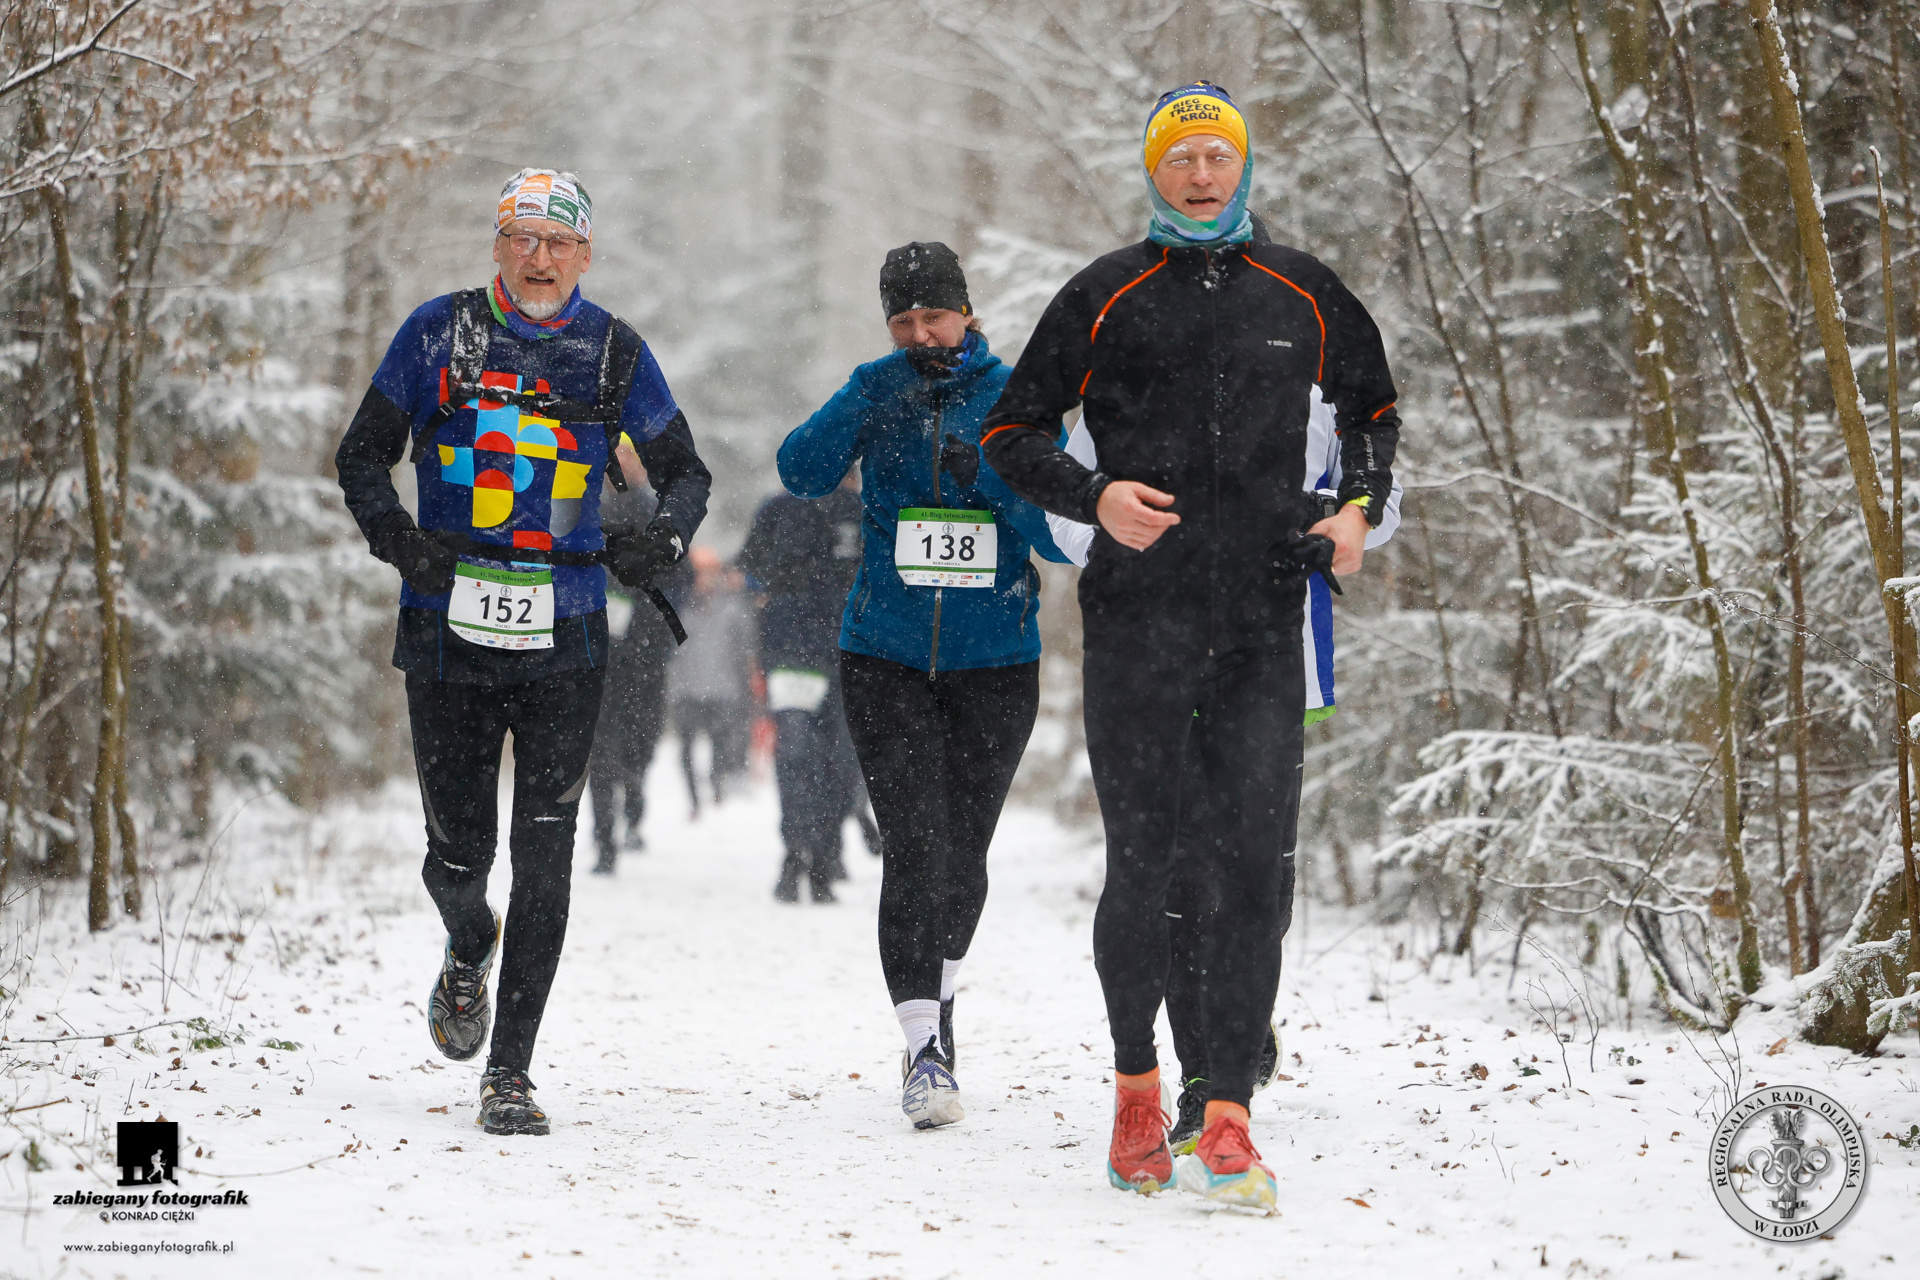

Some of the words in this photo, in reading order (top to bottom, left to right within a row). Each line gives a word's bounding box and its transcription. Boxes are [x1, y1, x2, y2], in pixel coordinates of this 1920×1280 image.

[1173, 98, 1200, 109] BIEG
[1169, 104, 1222, 118] TRZECH
[1180, 110, 1219, 123] KRÓLI
[921, 534, 975, 561] 138
[480, 594, 533, 624] 152
